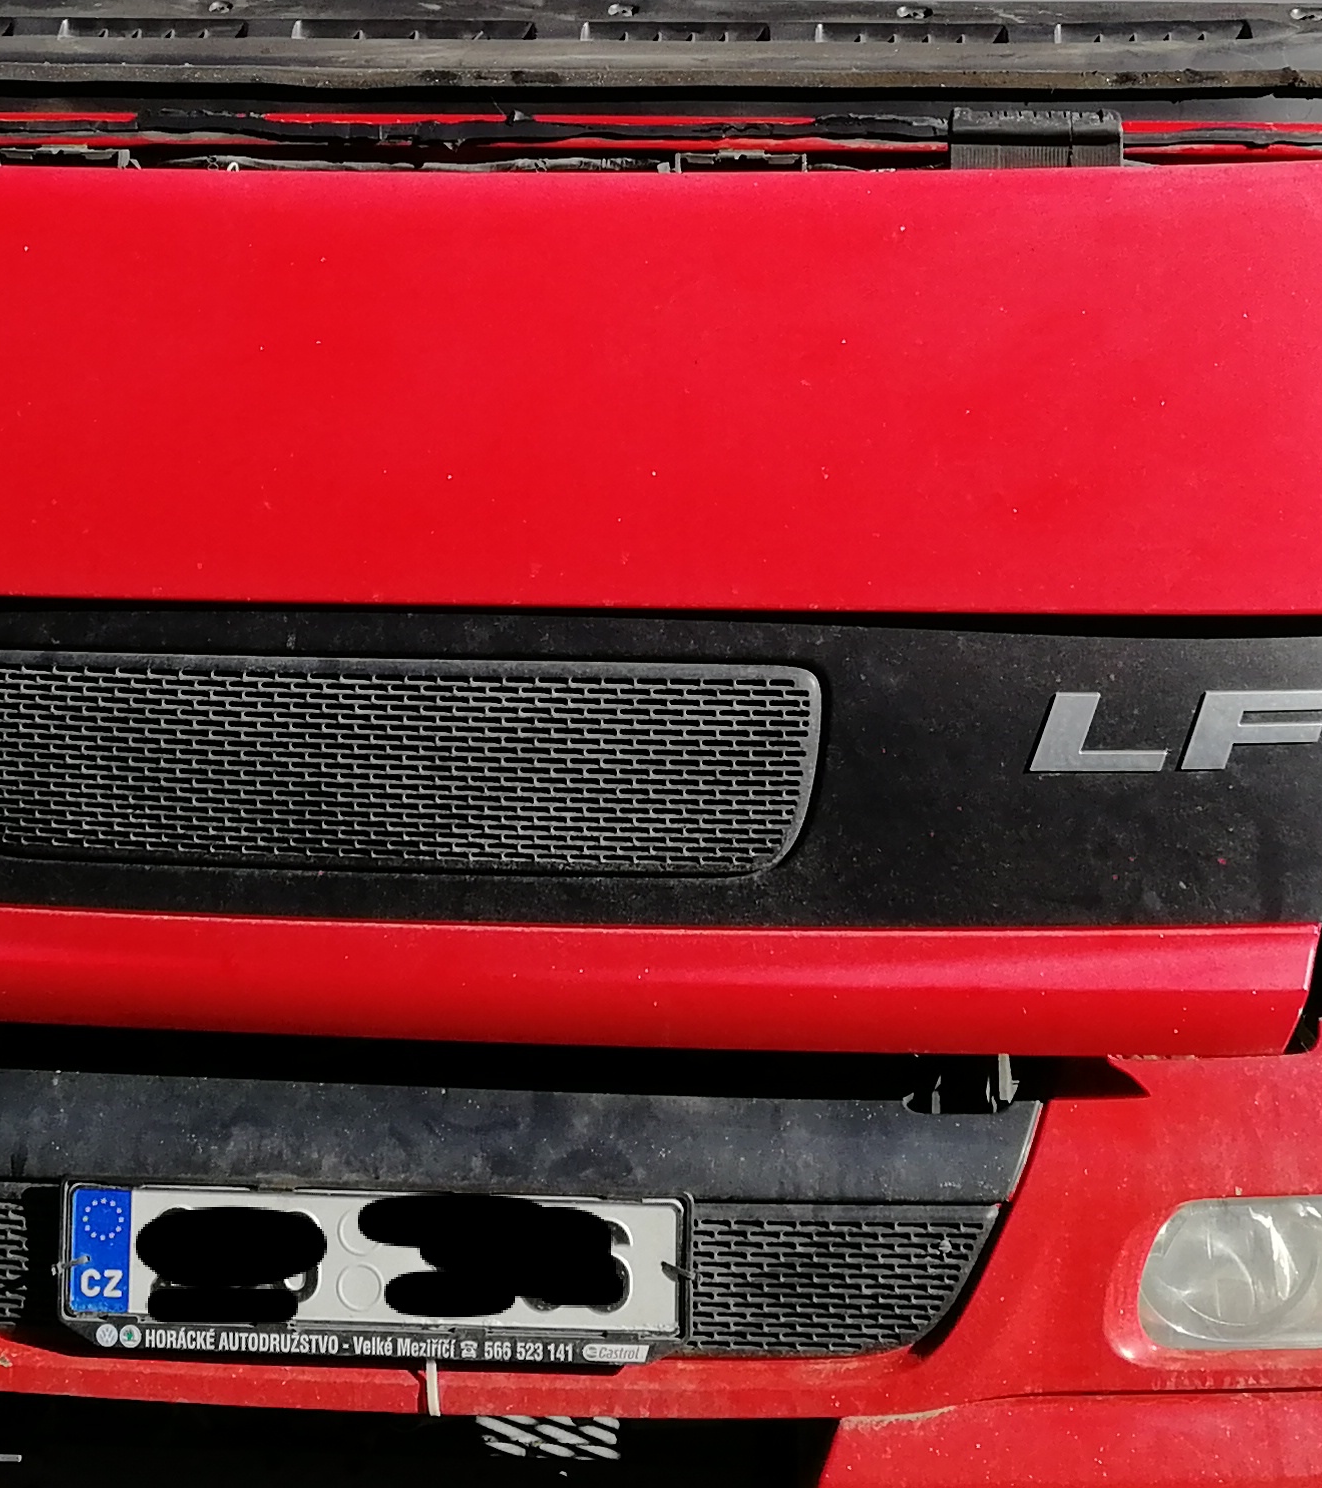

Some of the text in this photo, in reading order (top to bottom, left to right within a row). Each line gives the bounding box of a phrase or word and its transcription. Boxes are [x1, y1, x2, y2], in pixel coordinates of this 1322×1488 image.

[80, 1268, 124, 1298] CZ
[144, 1327, 216, 1350] HORÁCKÉ
[218, 1332, 339, 1354] AUTODRUŽSTVO
[352, 1338, 393, 1358] Velké
[395, 1338, 456, 1359] Meziříčí
[484, 1341, 512, 1361] 566
[516, 1342, 544, 1362] 523
[547, 1343, 574, 1362] 141
[597, 1346, 641, 1361] Castrol
